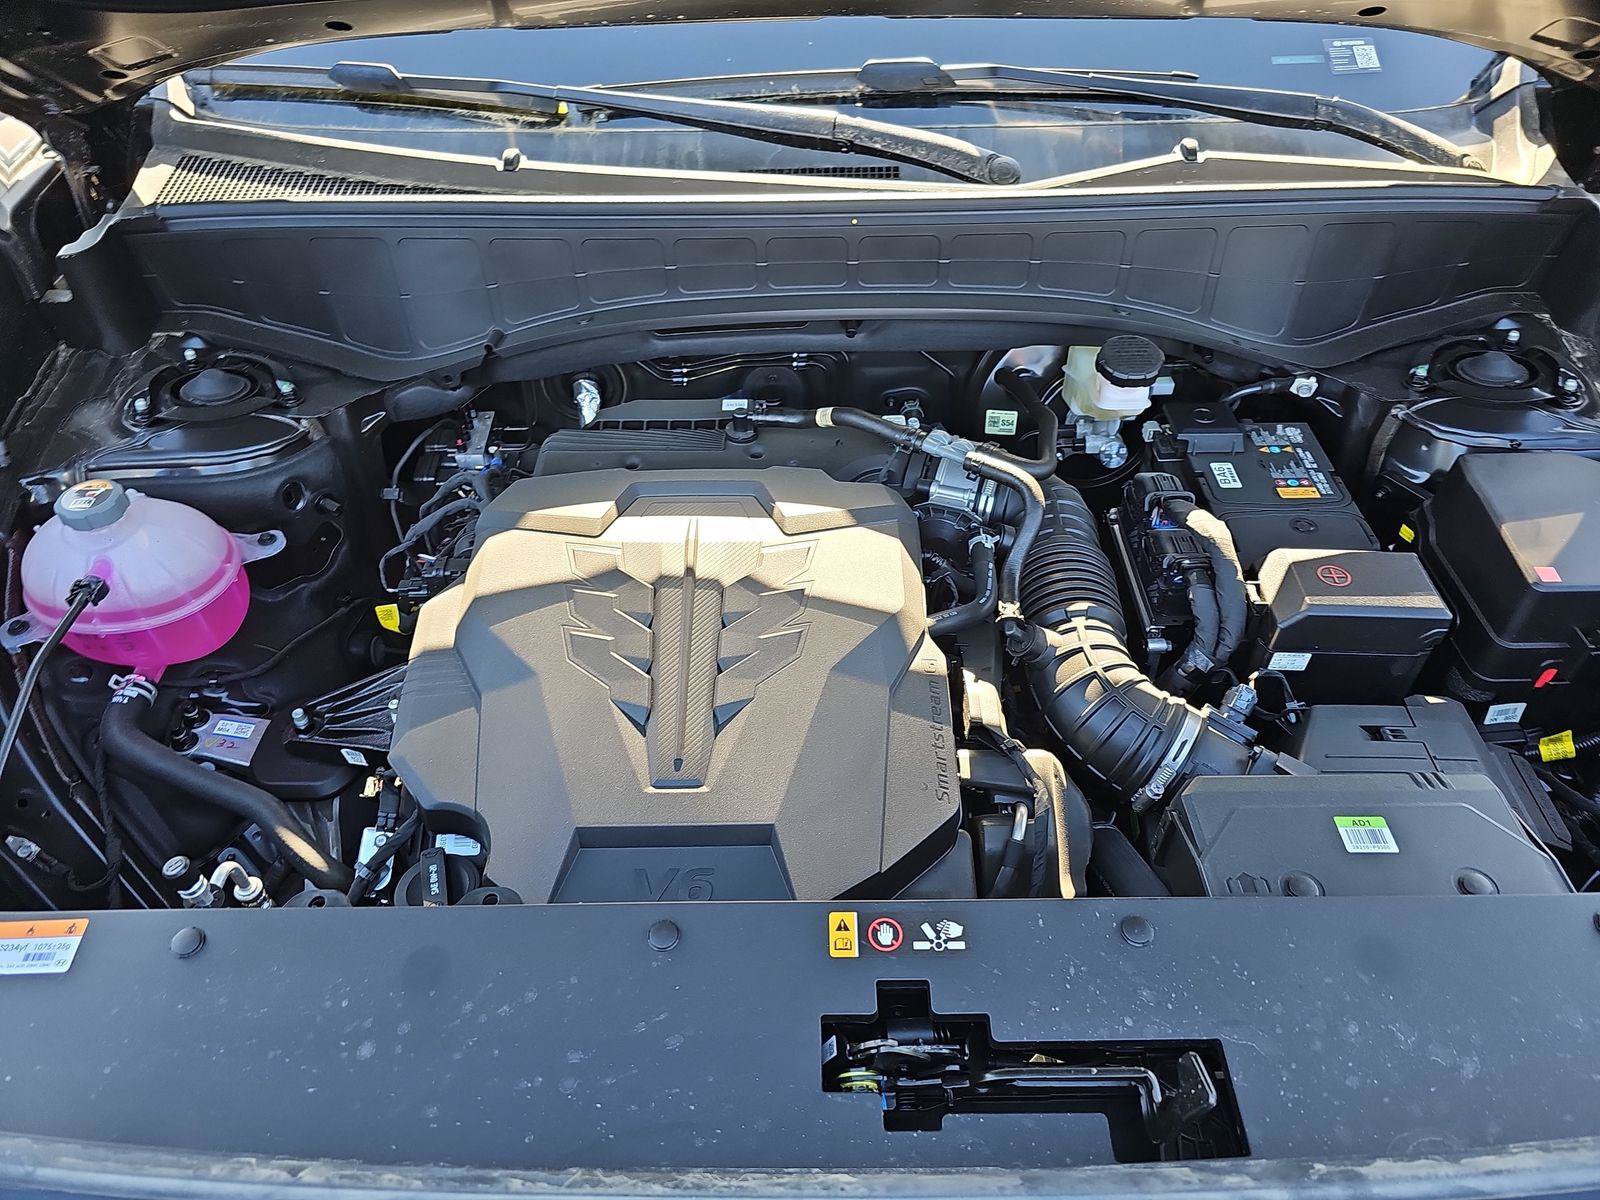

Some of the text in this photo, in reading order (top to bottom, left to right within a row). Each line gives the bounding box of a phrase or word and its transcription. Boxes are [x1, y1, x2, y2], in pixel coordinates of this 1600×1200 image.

[1214, 466, 1231, 485] BA6
[928, 680, 950, 804] Smartstream
[1351, 819, 1372, 827] AD1
[430, 882, 439, 896] SAE
[633, 867, 715, 901] V6
